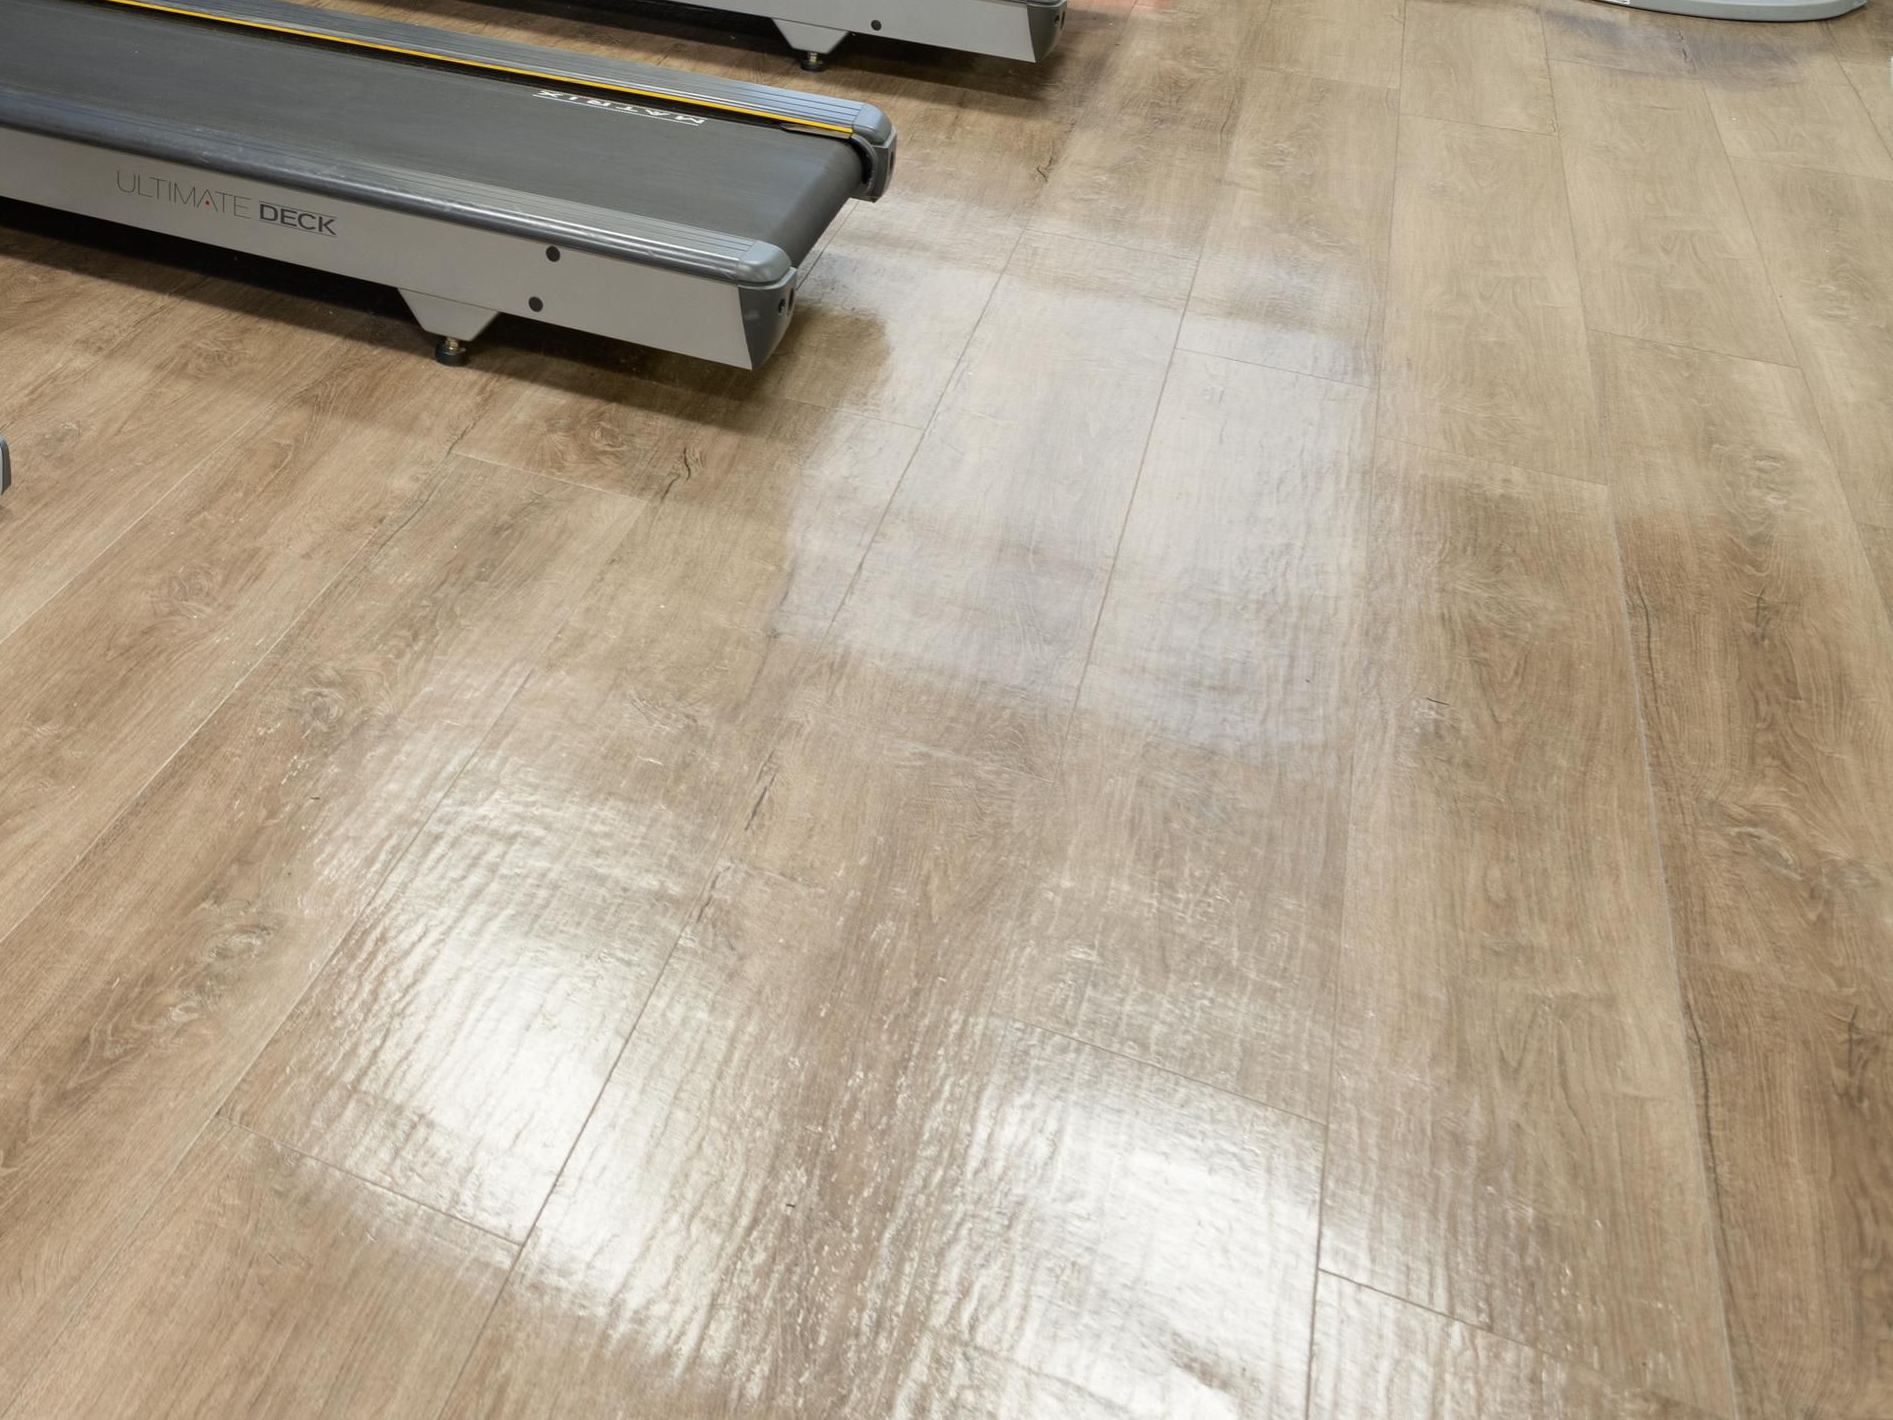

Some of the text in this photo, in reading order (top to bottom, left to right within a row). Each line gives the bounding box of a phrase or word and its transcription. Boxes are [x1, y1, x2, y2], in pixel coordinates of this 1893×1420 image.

[539, 89, 706, 125] MATRIX
[116, 170, 338, 236] ULTIMATE DECK
